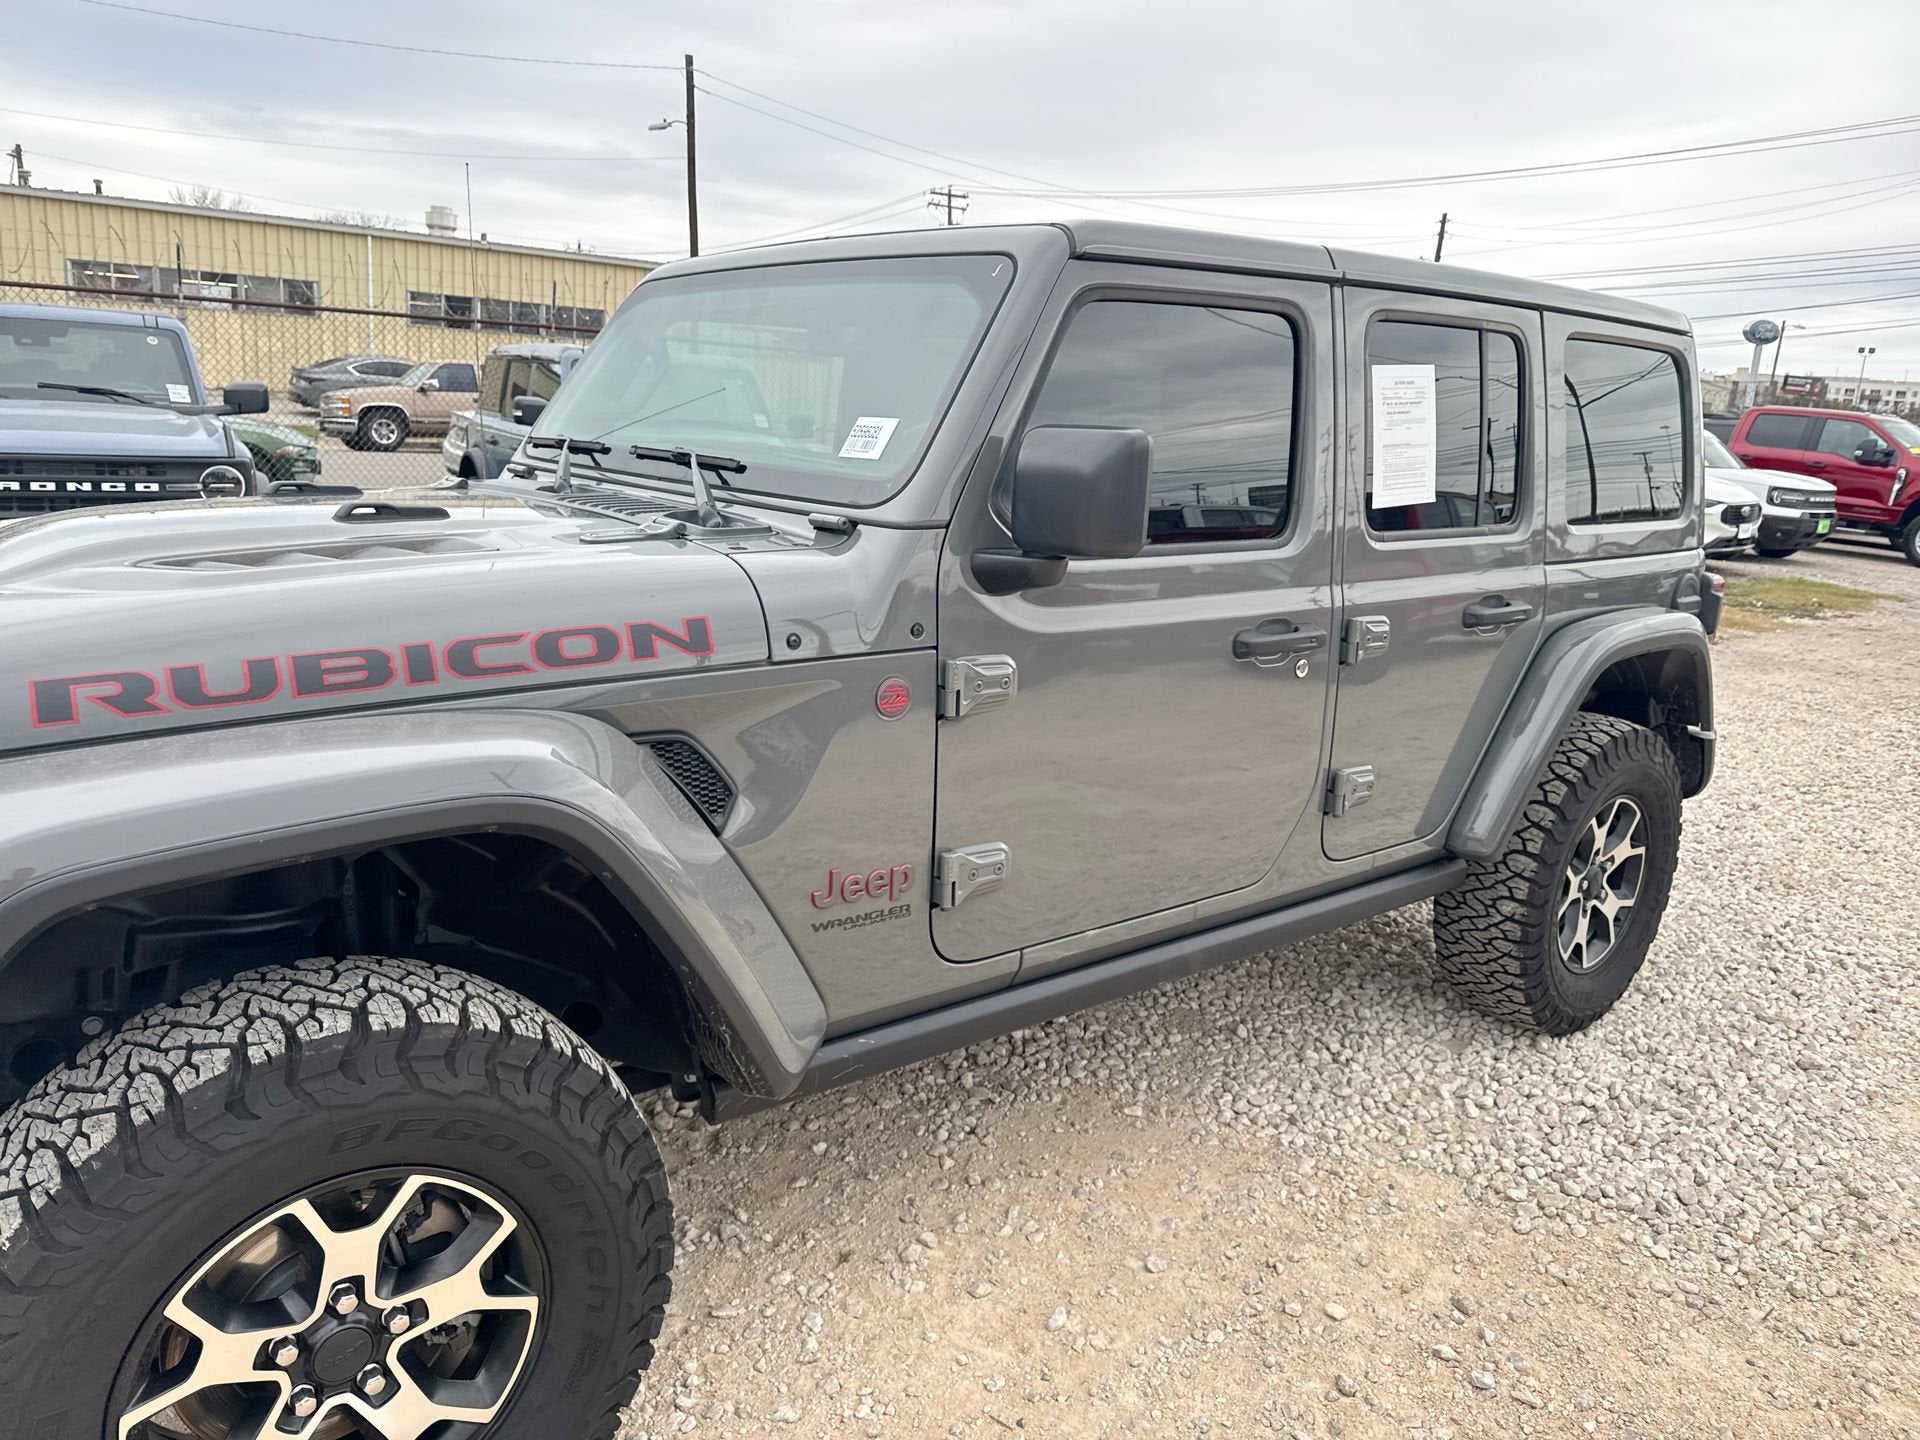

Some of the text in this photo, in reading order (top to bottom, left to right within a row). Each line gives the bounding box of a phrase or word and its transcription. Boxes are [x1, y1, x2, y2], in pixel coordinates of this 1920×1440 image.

[29, 615, 714, 729] RUBICON
[811, 863, 915, 910] Jeep
[811, 904, 912, 933] WRANGLER
[843, 912, 912, 931] UNLIMITED
